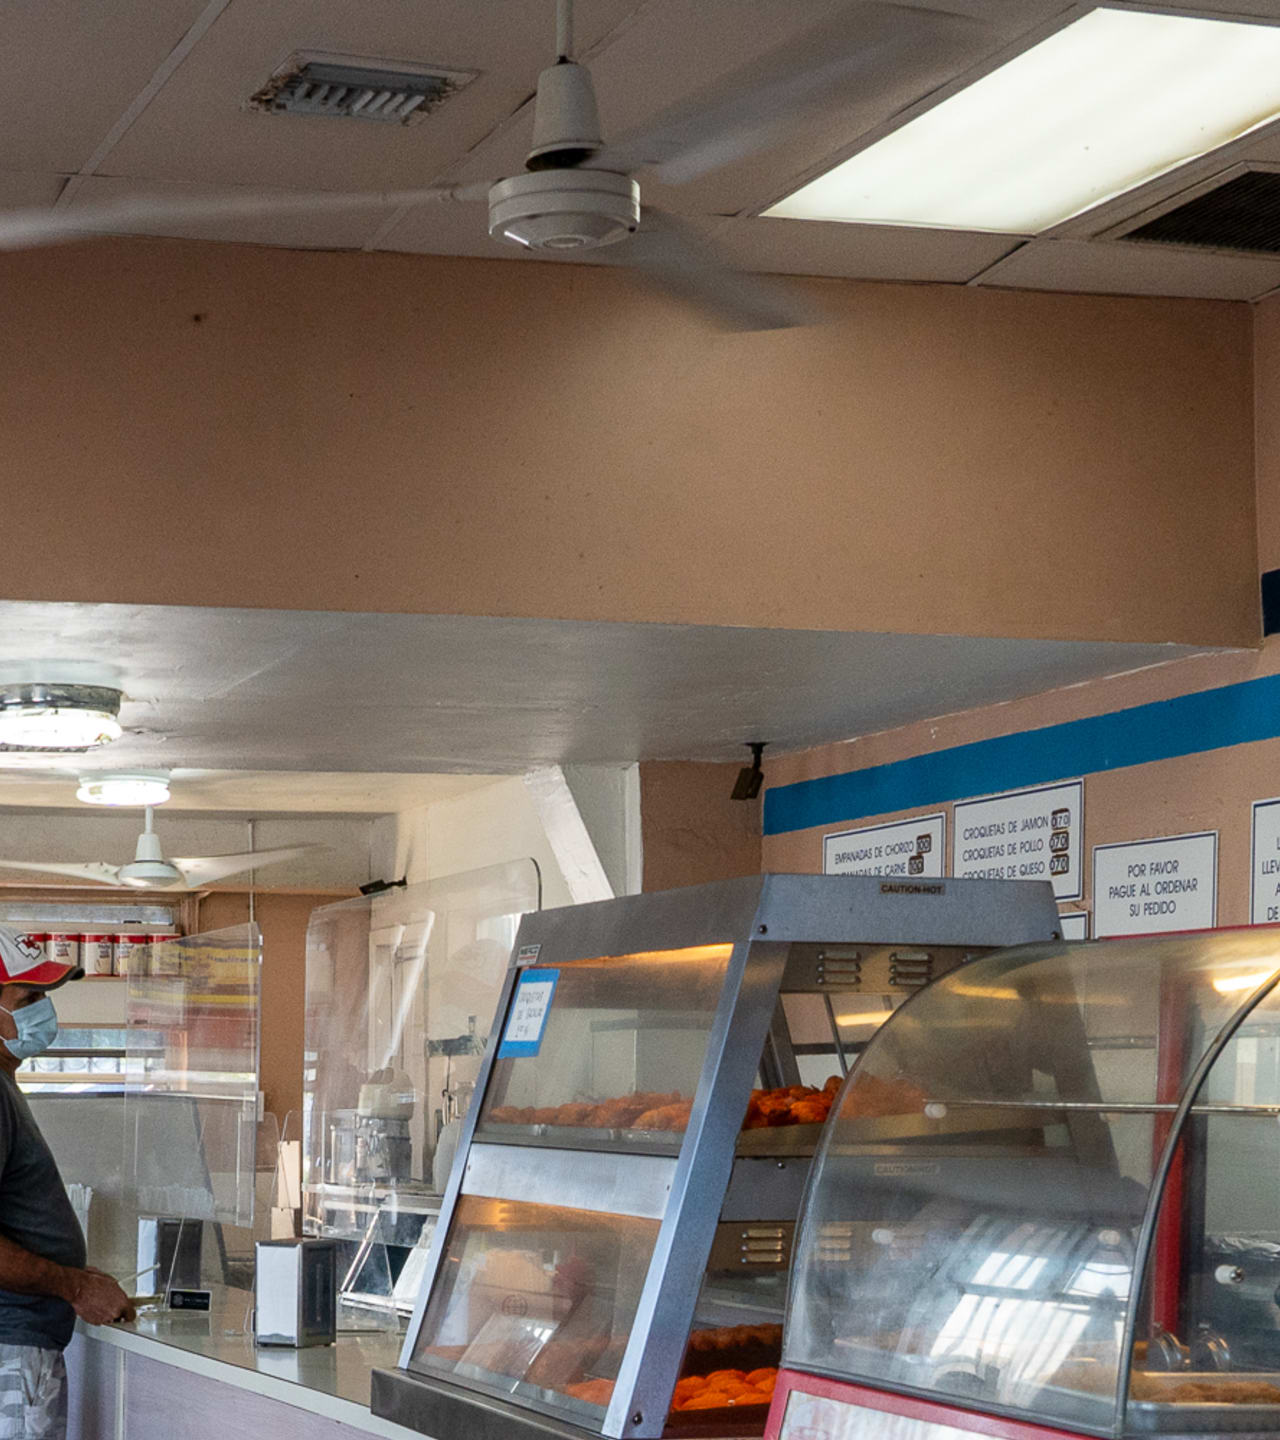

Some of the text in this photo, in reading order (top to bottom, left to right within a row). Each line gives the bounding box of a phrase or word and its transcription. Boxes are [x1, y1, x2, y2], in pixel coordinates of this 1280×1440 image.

[963, 822, 1006, 841] CROQUETAS
[1008, 820, 1018, 834] DE
[1020, 815, 1050, 832] JAMON
[834, 840, 915, 865] EMPANADAS DE CHORIZO
[962, 844, 1005, 862] CROQUETAS
[1007, 842, 1017, 856] DE
[1020, 838, 1044, 853] POLLO
[1006, 865, 1017, 878] DE
[1019, 861, 1045, 876] QUESO
[1127, 860, 1180, 878] POR FAVOR
[1108, 877, 1198, 900] PAGUE AL ORDENAR
[1129, 900, 1177, 918] SU PEDIDO
[1267, 906, 1279, 921] DE
